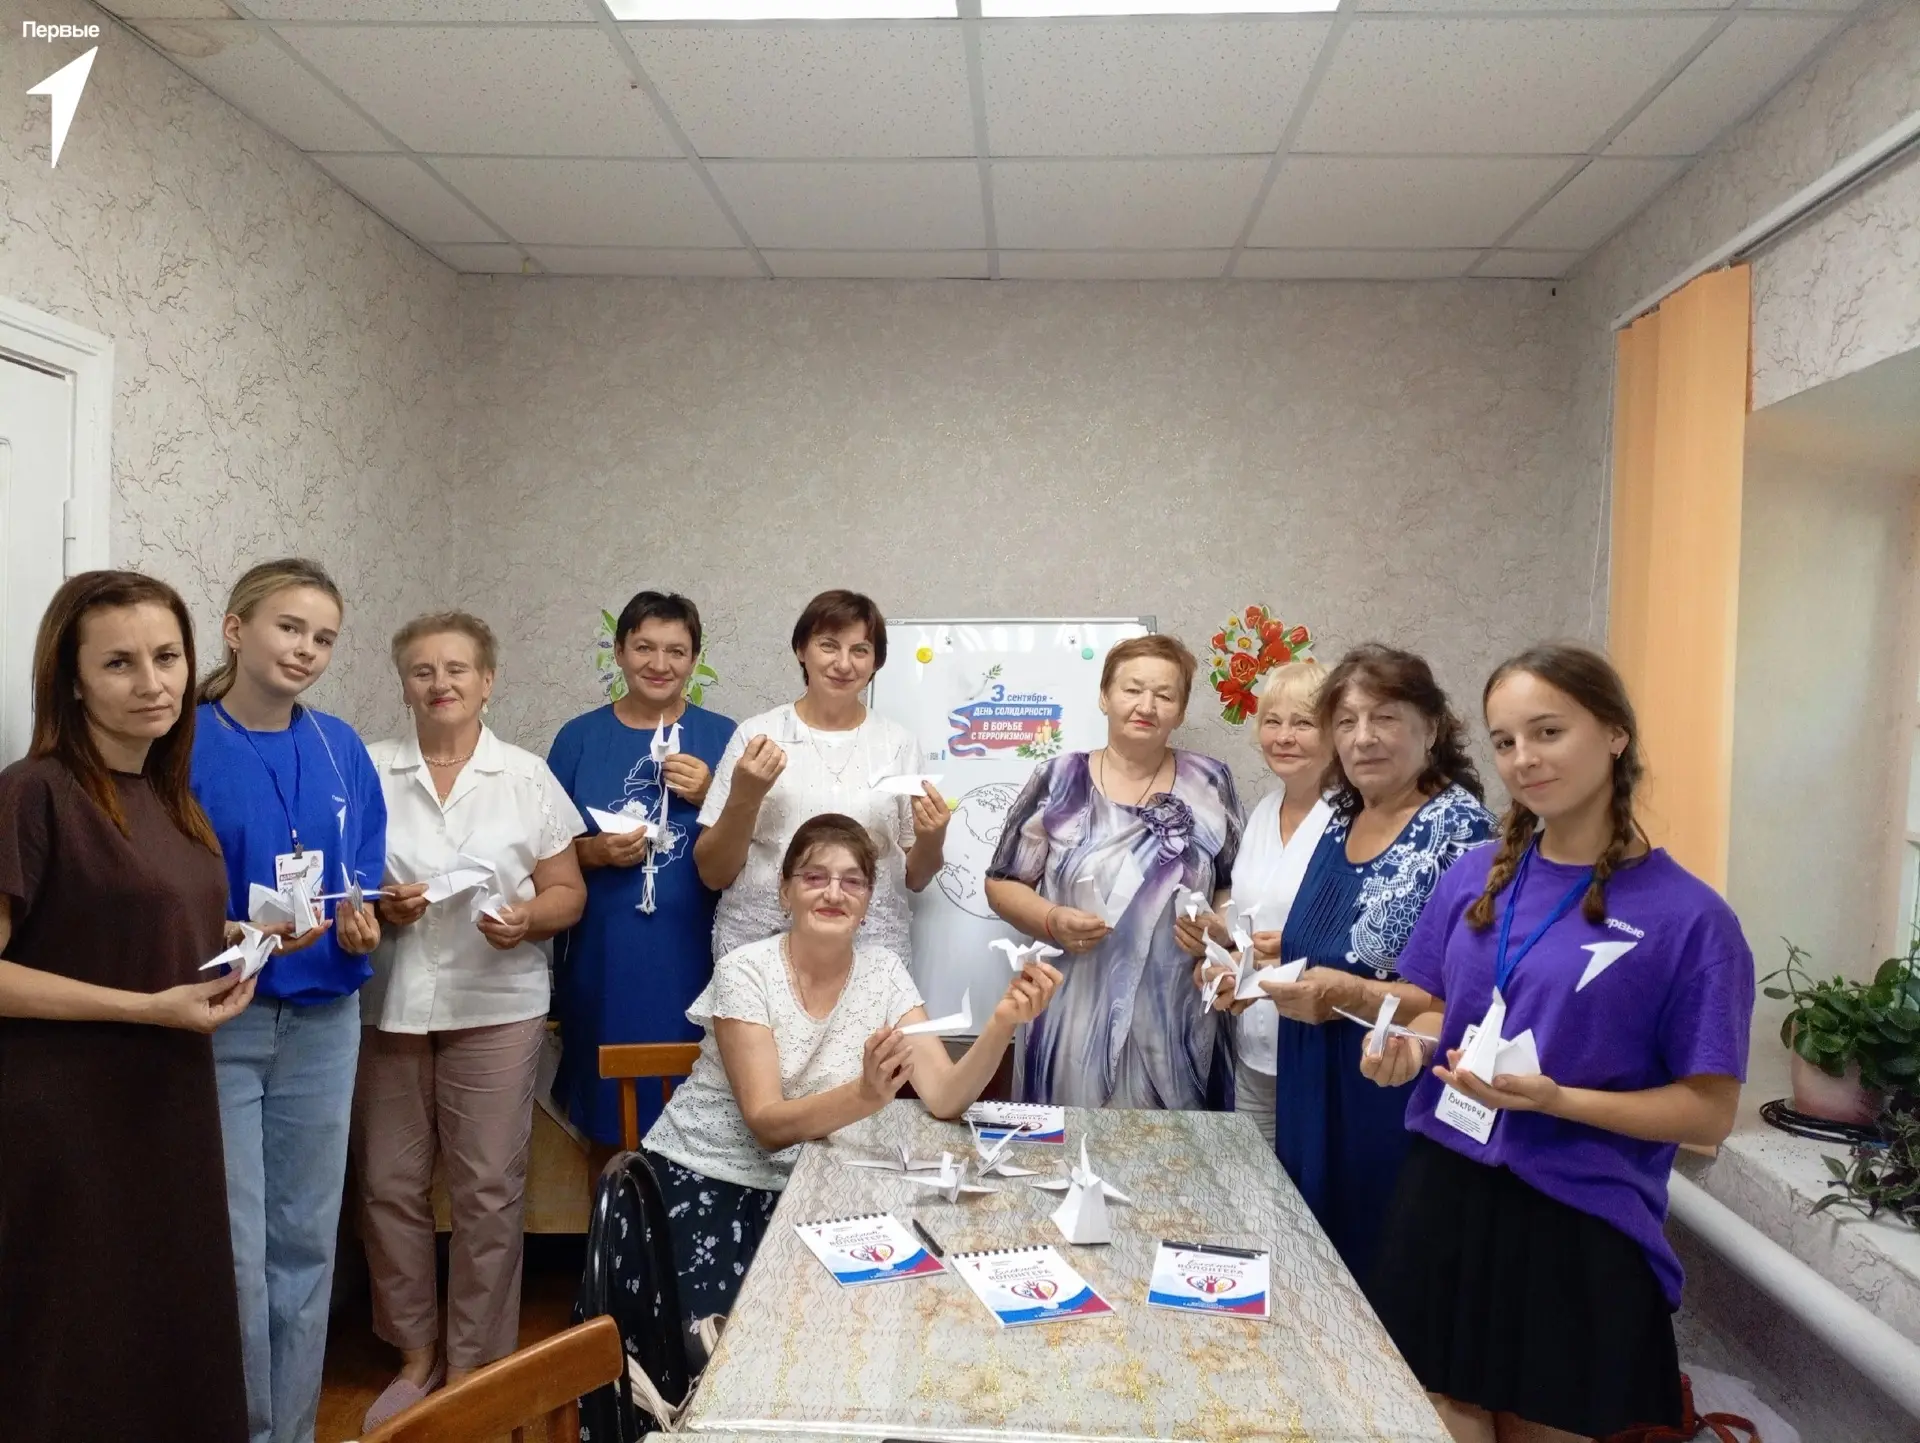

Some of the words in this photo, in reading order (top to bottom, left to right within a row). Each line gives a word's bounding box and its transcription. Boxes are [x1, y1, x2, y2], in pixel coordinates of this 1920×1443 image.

[990, 684, 1005, 702] 3
[1007, 693, 1047, 703] сентября
[973, 707, 994, 717] ДЕНЬ
[994, 707, 1053, 717] СОЛИДАРНОСТИ
[983, 722, 989, 731] В
[991, 722, 1023, 731] БОРЬБЕ
[971, 732, 976, 740] С
[978, 732, 1033, 741] ТЕРРОРИЗМОМ!
